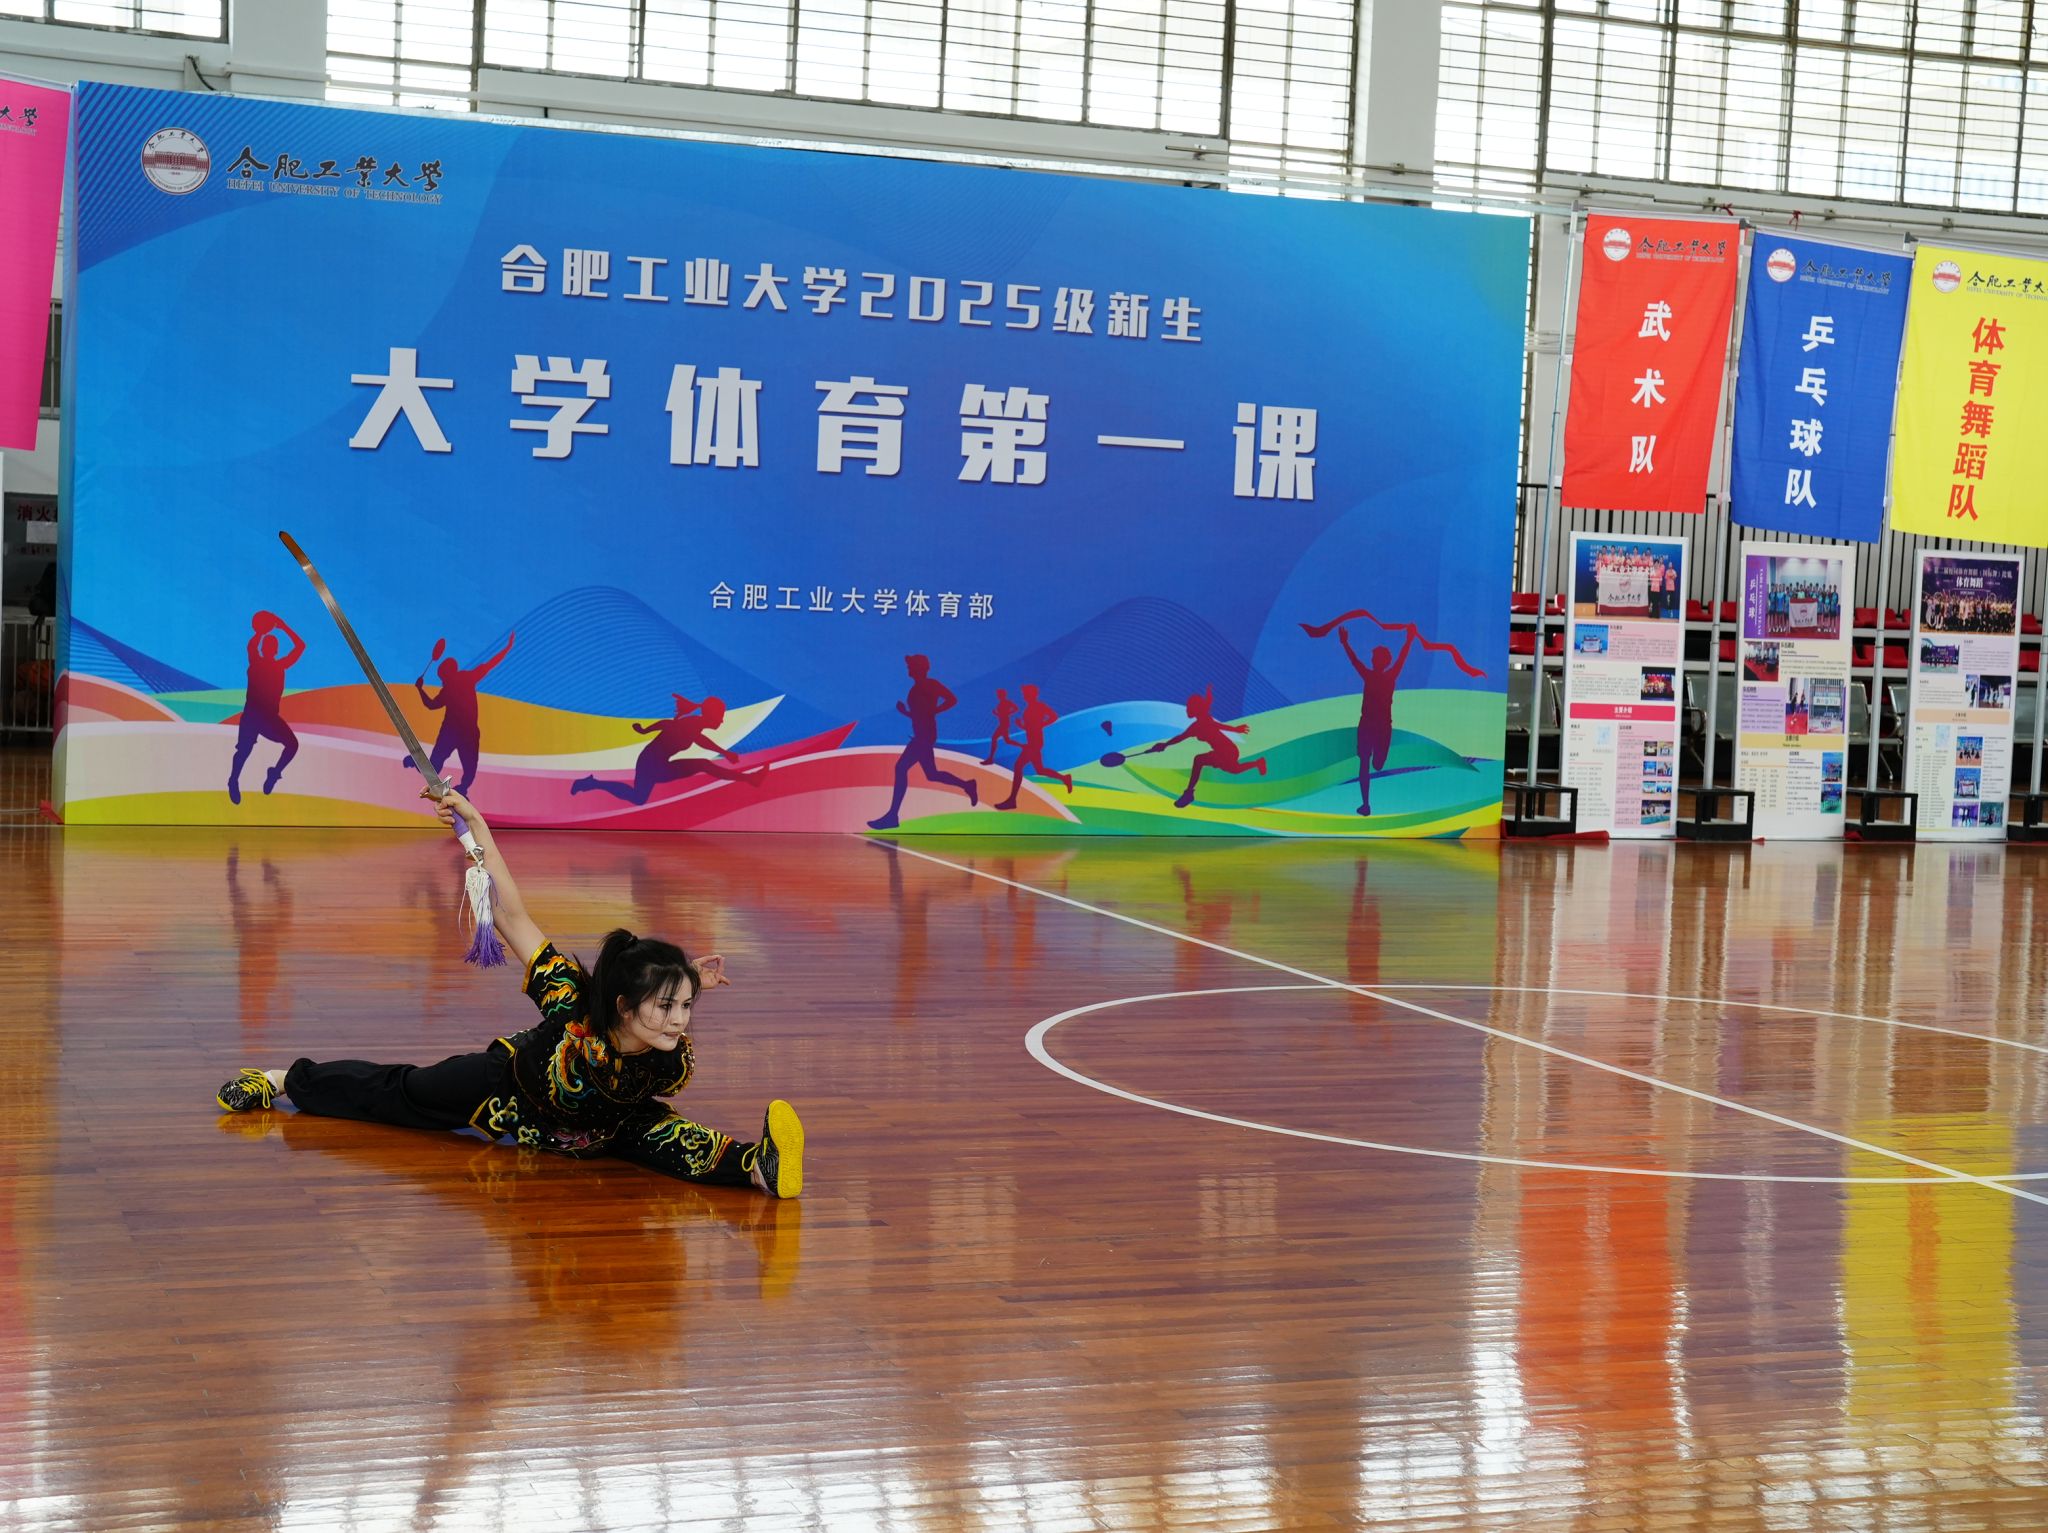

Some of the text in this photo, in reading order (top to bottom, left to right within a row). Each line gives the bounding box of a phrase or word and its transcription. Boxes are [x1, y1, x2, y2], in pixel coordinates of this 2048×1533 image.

[226, 178, 443, 205] HEFEI UNIVERSITY OF TECHNOLOGY
[501, 244, 1202, 343] 合肥工业大学2025级新生
[349, 347, 1318, 501] 大学体育第一课
[1628, 300, 1672, 474] 武术队
[1784, 315, 1835, 508] 乒乓球队
[1947, 317, 2006, 521] 体育舞蹈队
[17, 504, 57, 523] 消火
[710, 581, 994, 620] 合肥工业大学体育部
